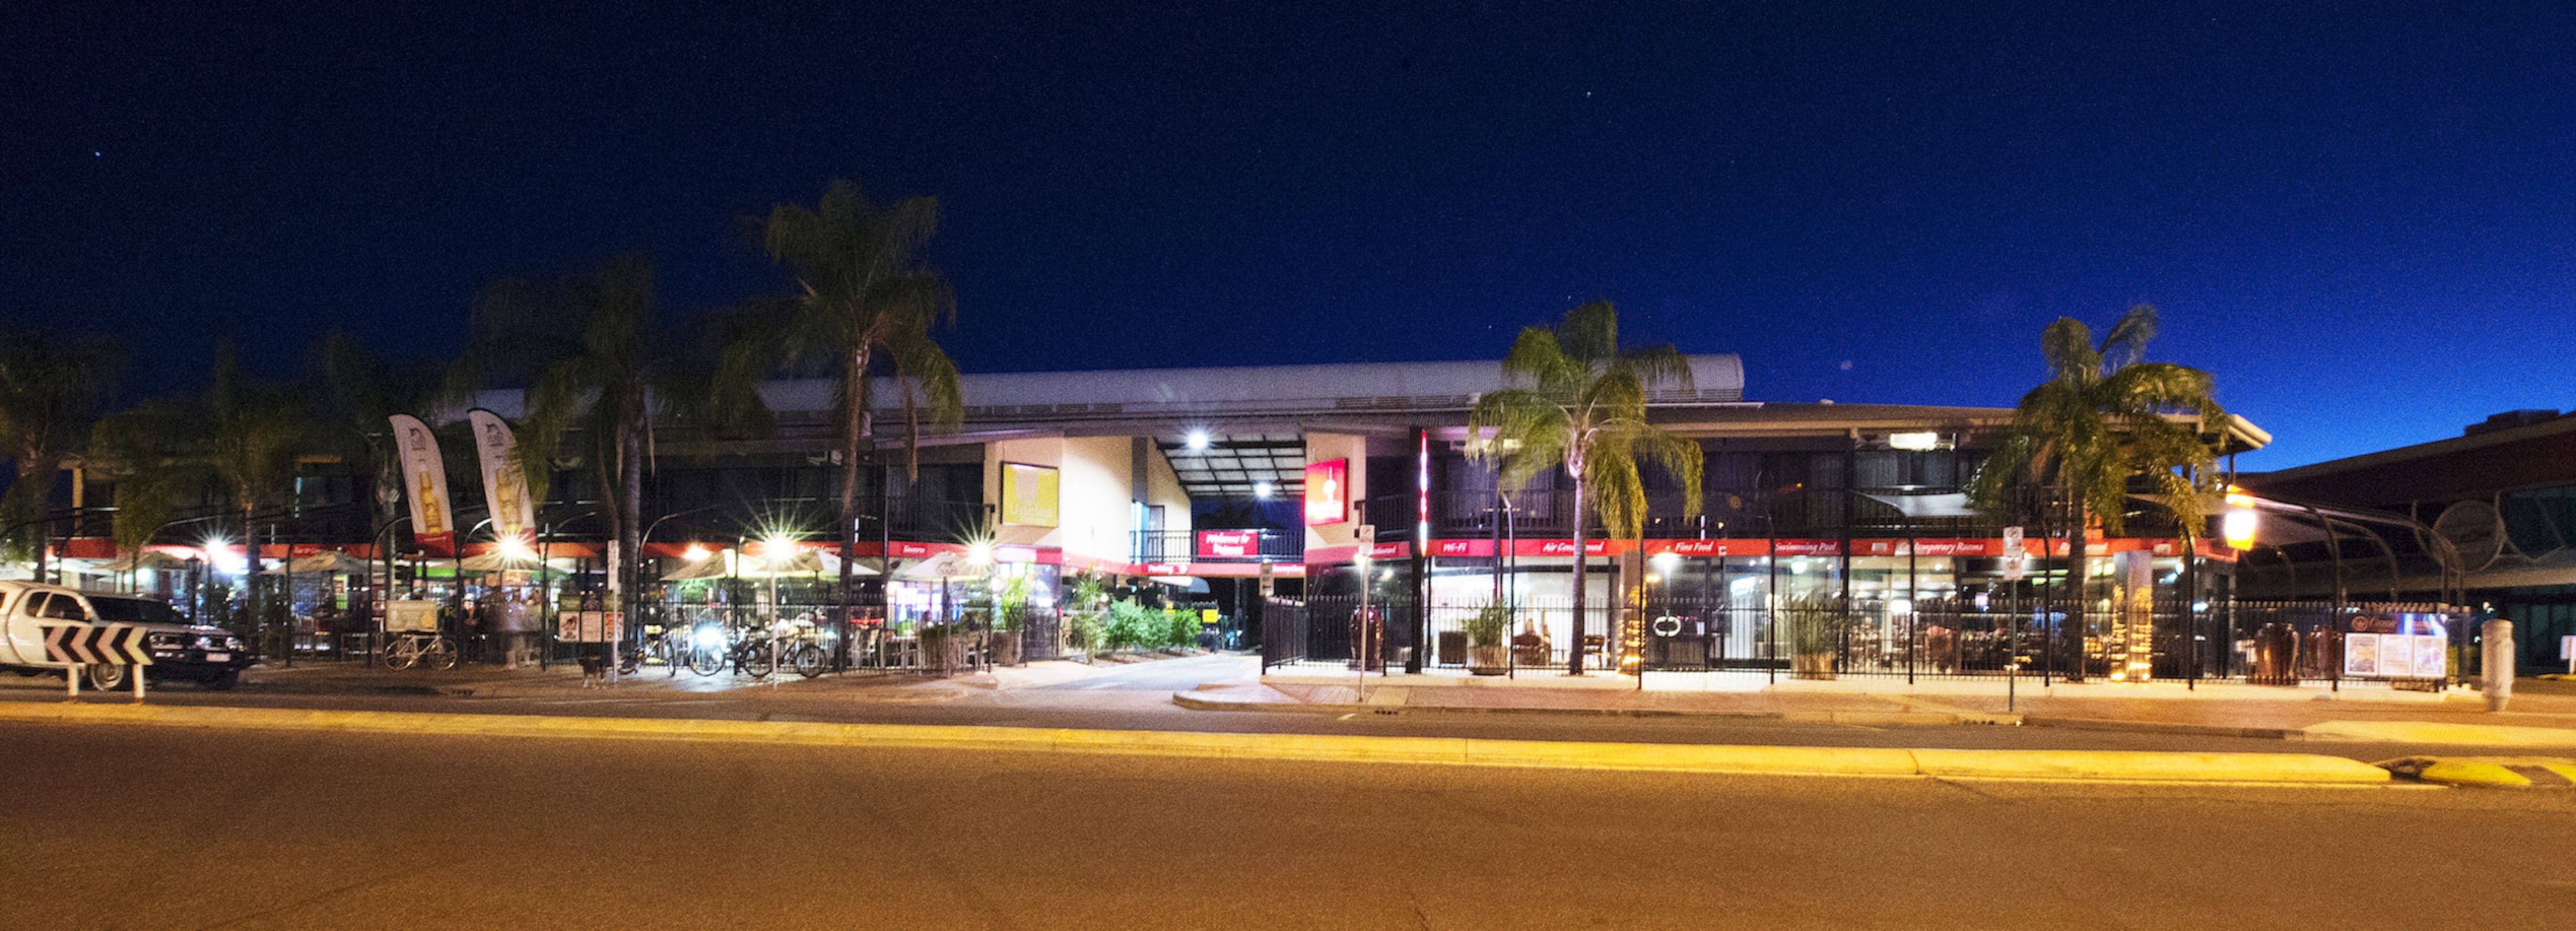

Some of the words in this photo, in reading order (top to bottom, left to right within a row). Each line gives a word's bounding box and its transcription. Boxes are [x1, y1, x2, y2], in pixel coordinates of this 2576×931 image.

[1010, 504, 1053, 518] Uncles
[1443, 542, 1468, 553] Wi-Fi
[1542, 542, 1558, 552] Air
[1674, 542, 1693, 553] Fine
[1693, 541, 1715, 552] Food
[1774, 542, 1819, 555] Swimming
[1819, 542, 1837, 551] Pool
[1956, 542, 1984, 551] Rooms
